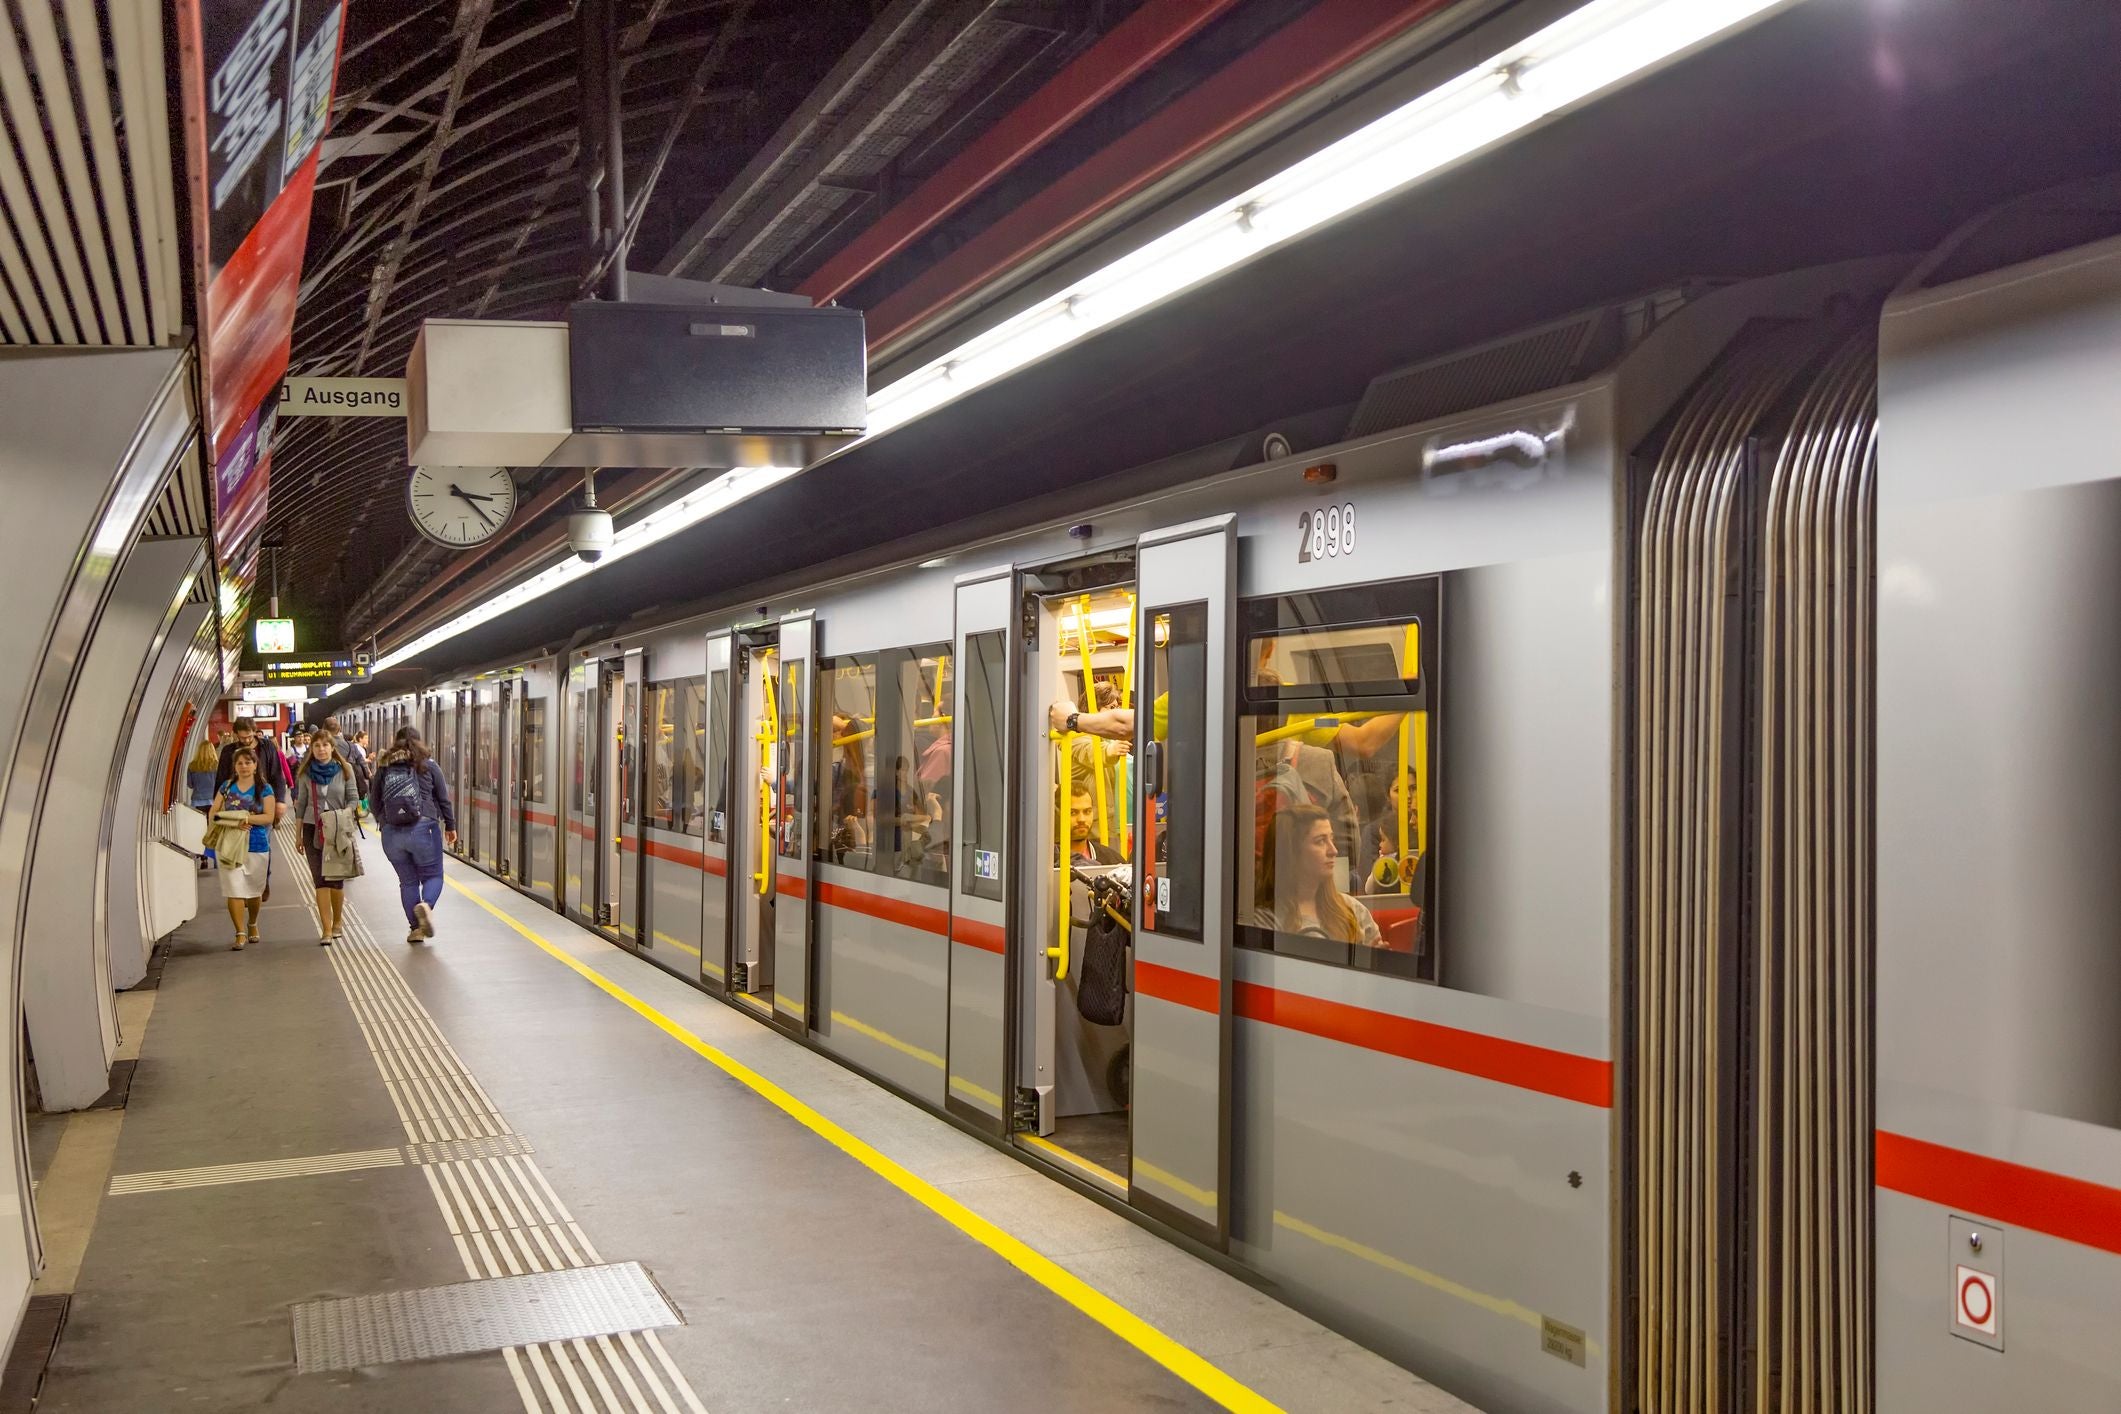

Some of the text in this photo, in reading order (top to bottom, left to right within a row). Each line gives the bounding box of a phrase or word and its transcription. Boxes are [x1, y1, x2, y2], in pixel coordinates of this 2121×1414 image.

[304, 387, 400, 408] Ausgang
[1298, 502, 1356, 563] 2898
[281, 670, 331, 678] REUMANNPLATZ
